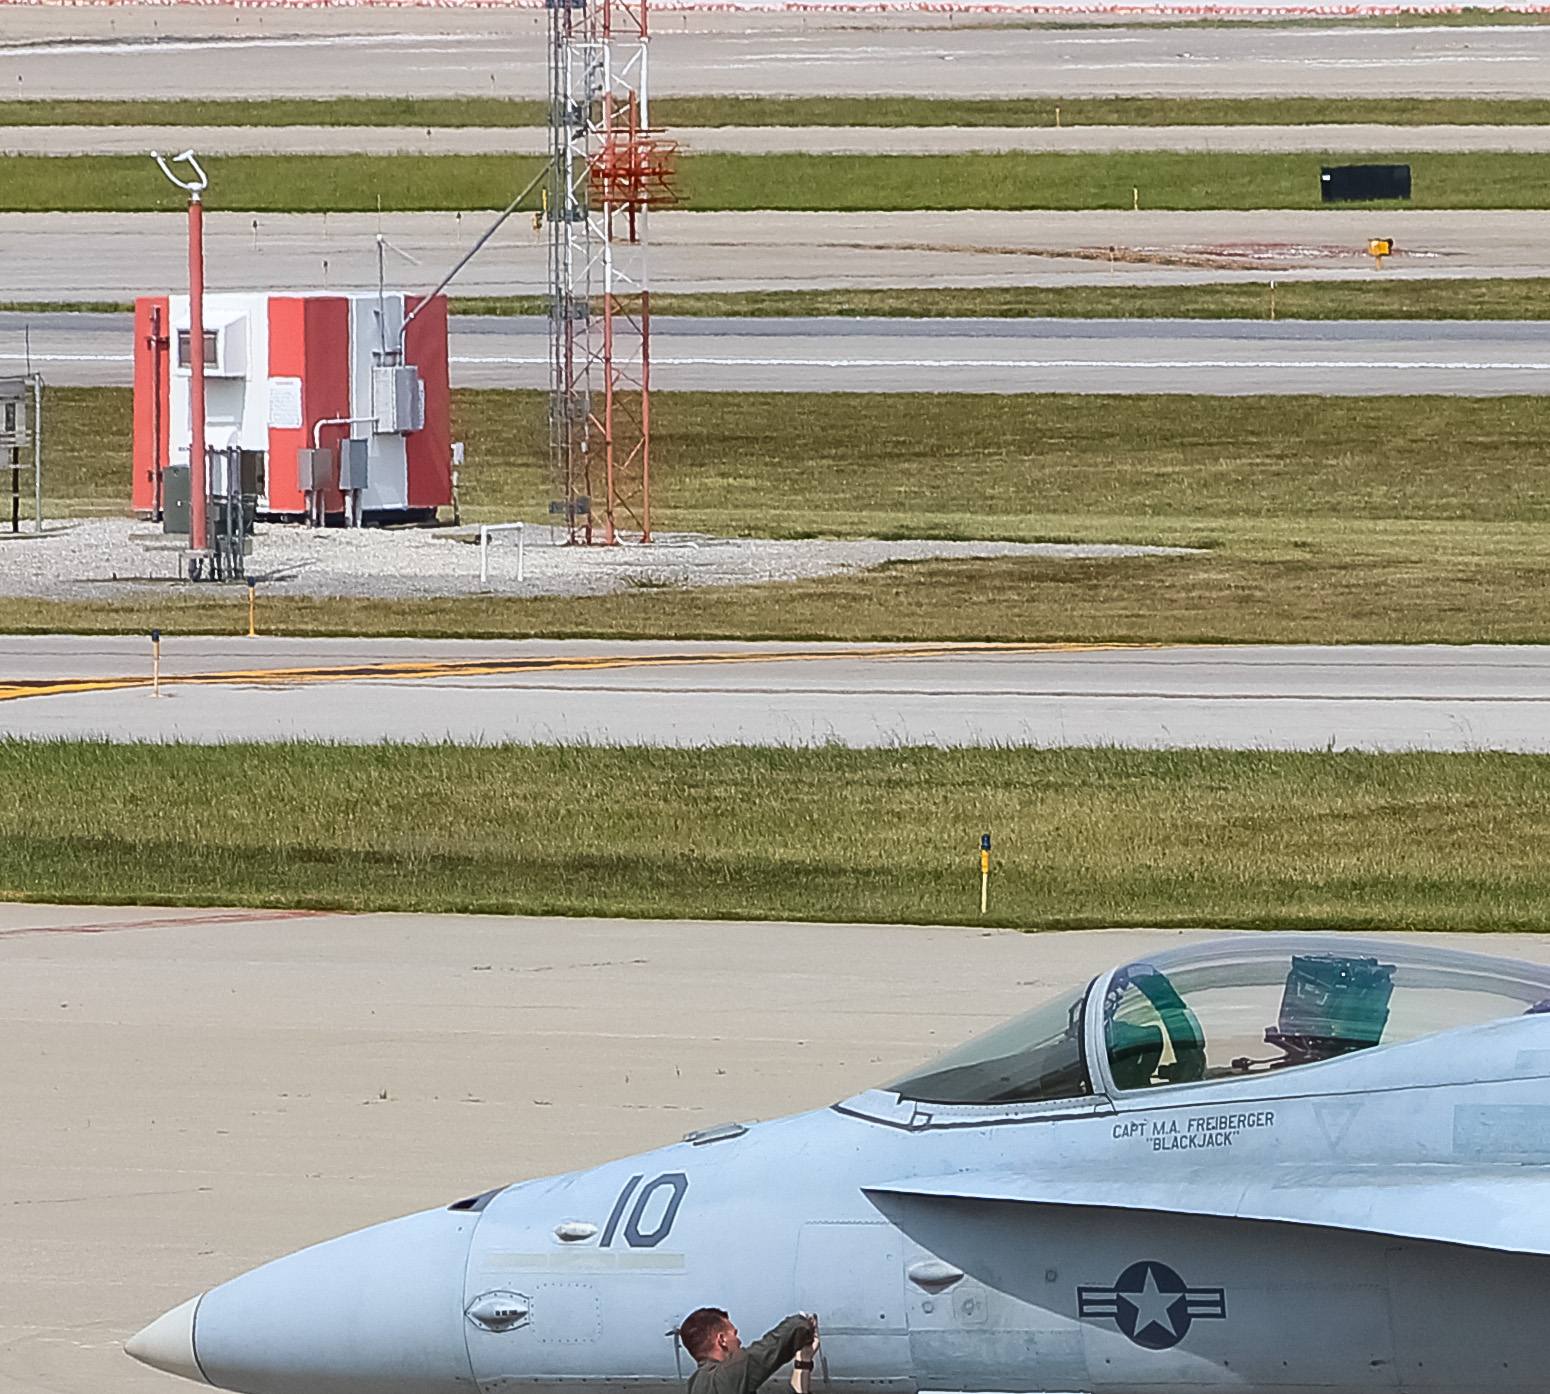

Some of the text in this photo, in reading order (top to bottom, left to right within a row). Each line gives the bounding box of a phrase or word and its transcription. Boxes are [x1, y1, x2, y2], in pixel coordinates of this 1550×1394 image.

[1112, 1111, 1275, 1139] CAPT M.A. FREIBERGER
[1146, 1130, 1241, 1151] "BLACKJACK"
[599, 1170, 690, 1249] 10
